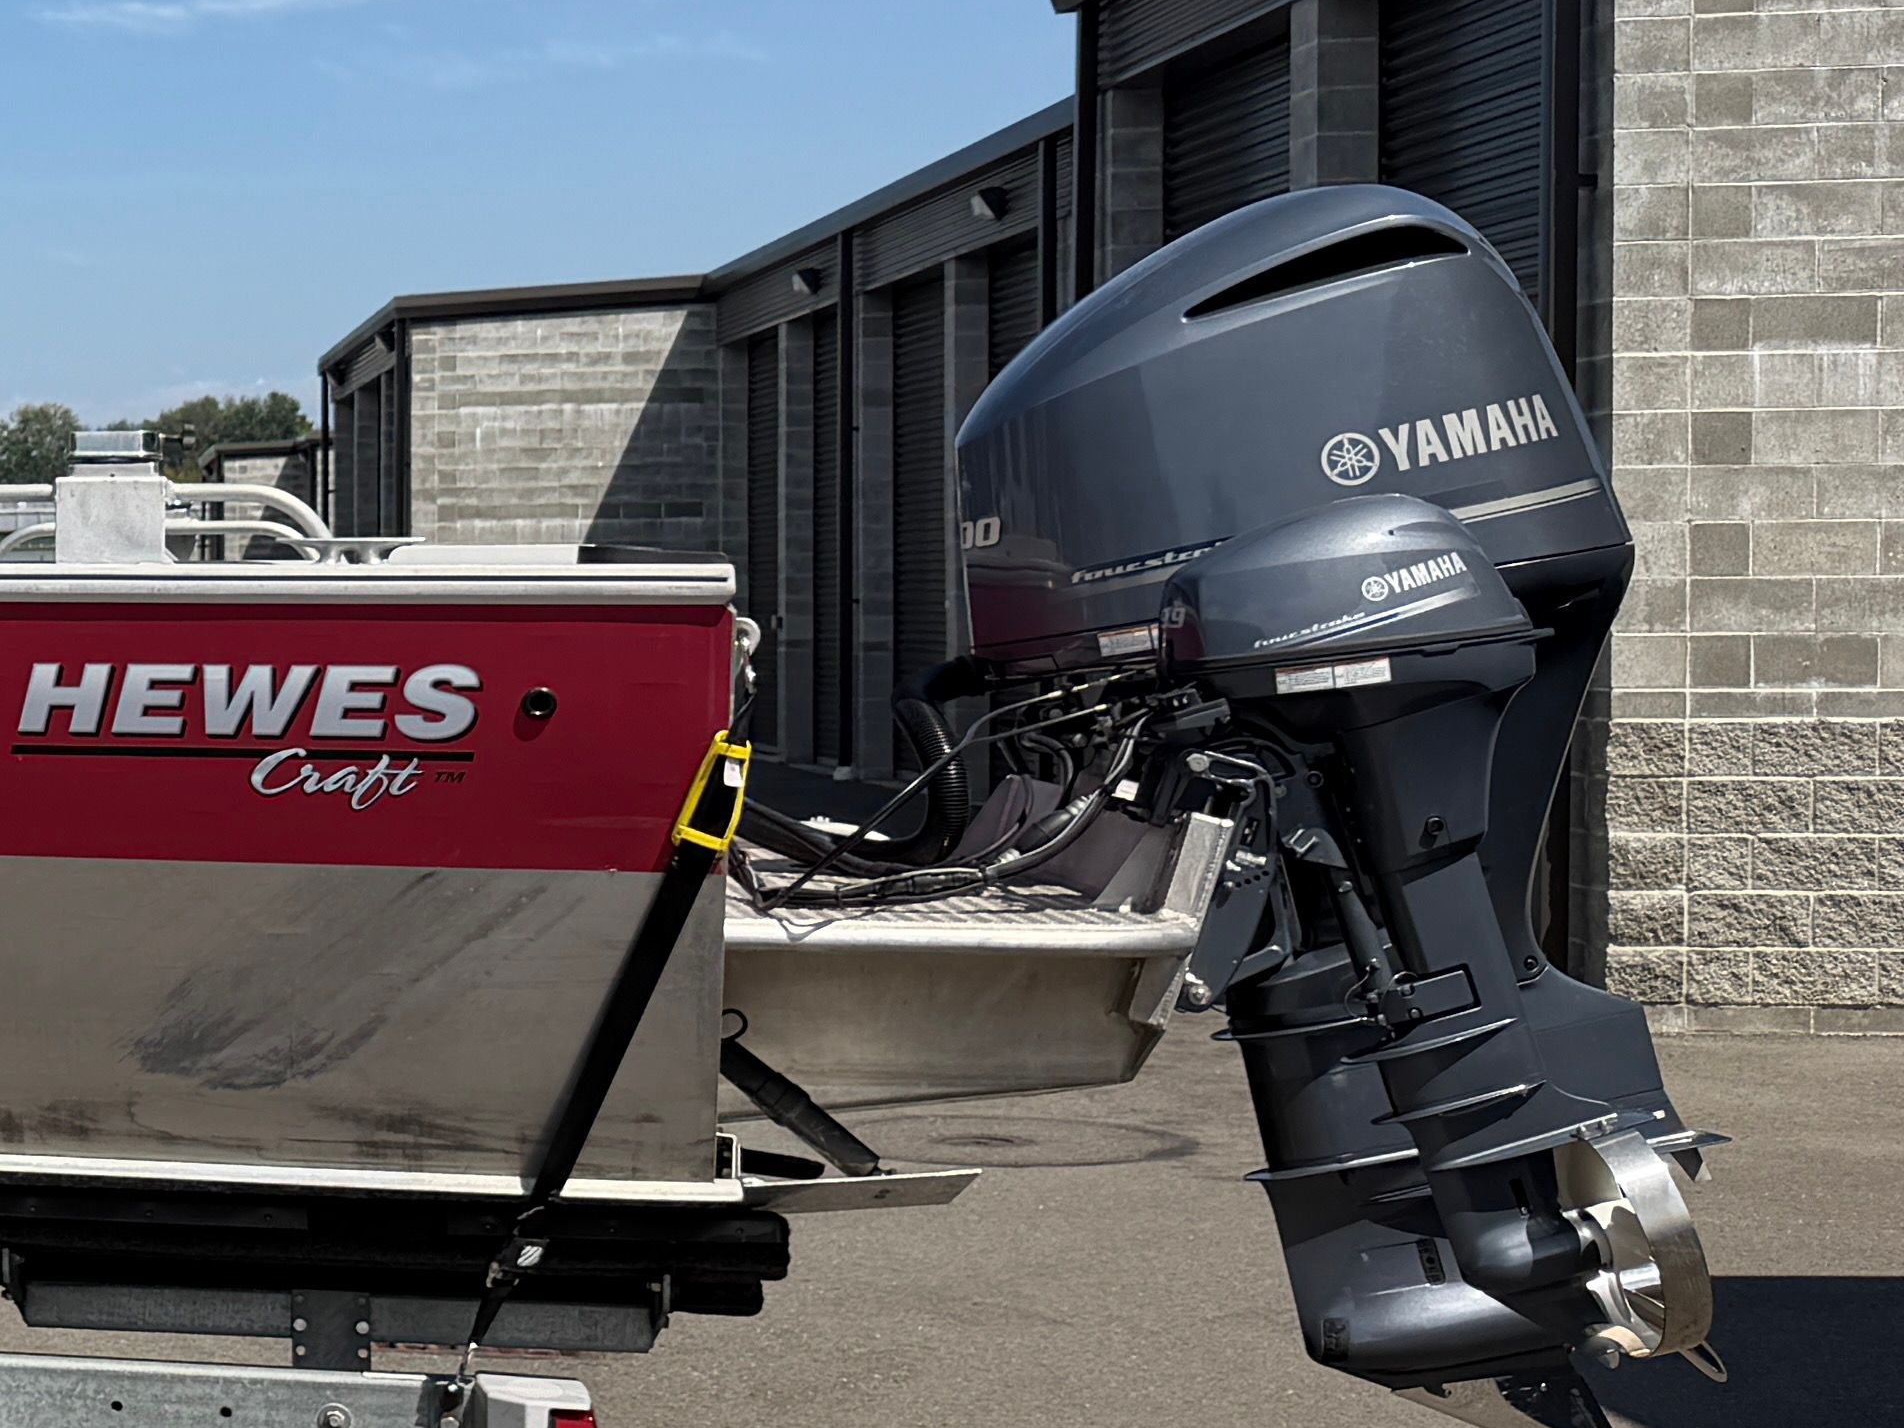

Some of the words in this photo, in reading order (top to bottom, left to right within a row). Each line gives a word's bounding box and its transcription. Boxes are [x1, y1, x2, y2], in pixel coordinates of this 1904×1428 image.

[1378, 394, 1559, 471] YAMAHA
[1383, 552, 1468, 594] YAMAHA
[16, 662, 482, 741] HEWES
[249, 747, 424, 811] Craft
